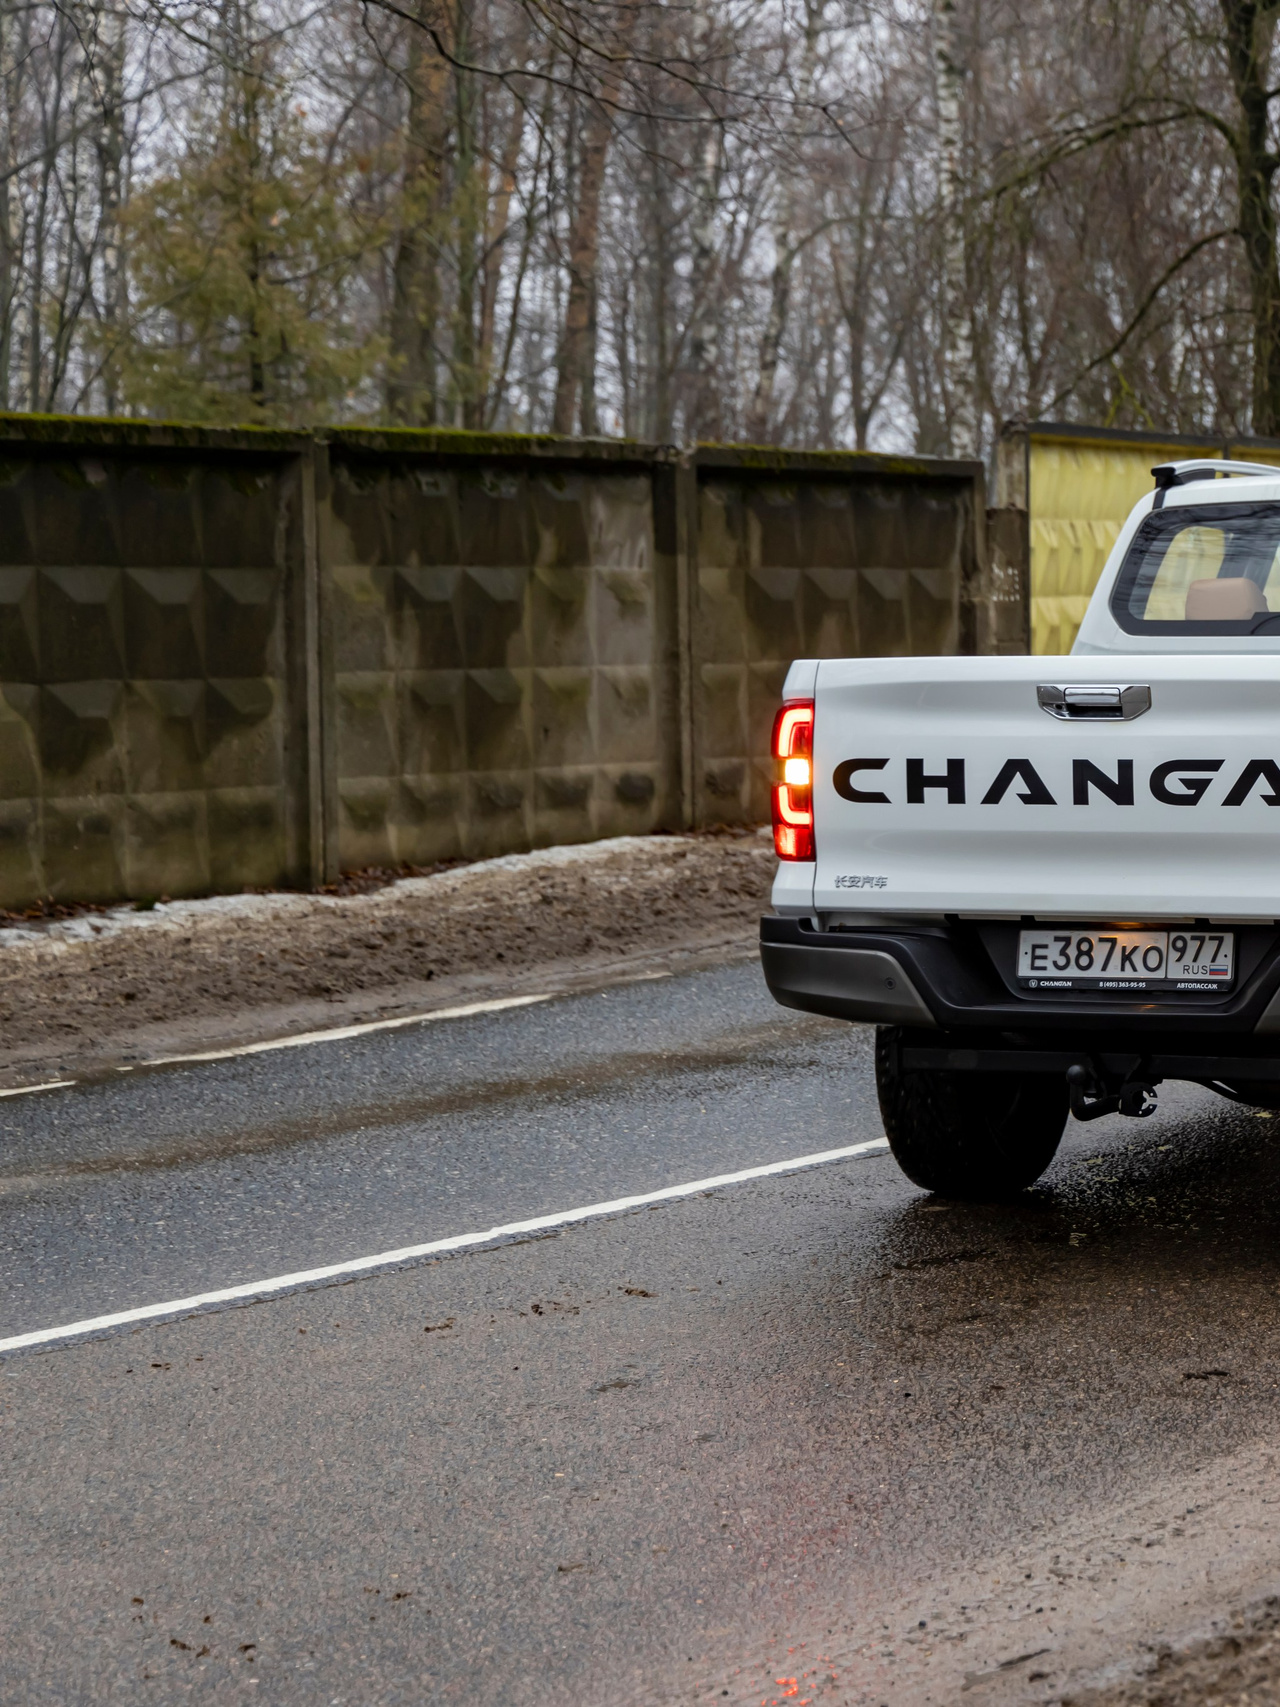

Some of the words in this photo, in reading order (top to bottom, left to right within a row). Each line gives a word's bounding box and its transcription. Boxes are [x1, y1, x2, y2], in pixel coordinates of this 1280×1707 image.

[834, 874, 888, 888] 长安汽车
[1171, 935, 1224, 962] 977
[1182, 965, 1208, 975] RUS
[1104, 981, 1117, 989] (495)
[1176, 982, 1218, 990] АВТОПАССАЖ
